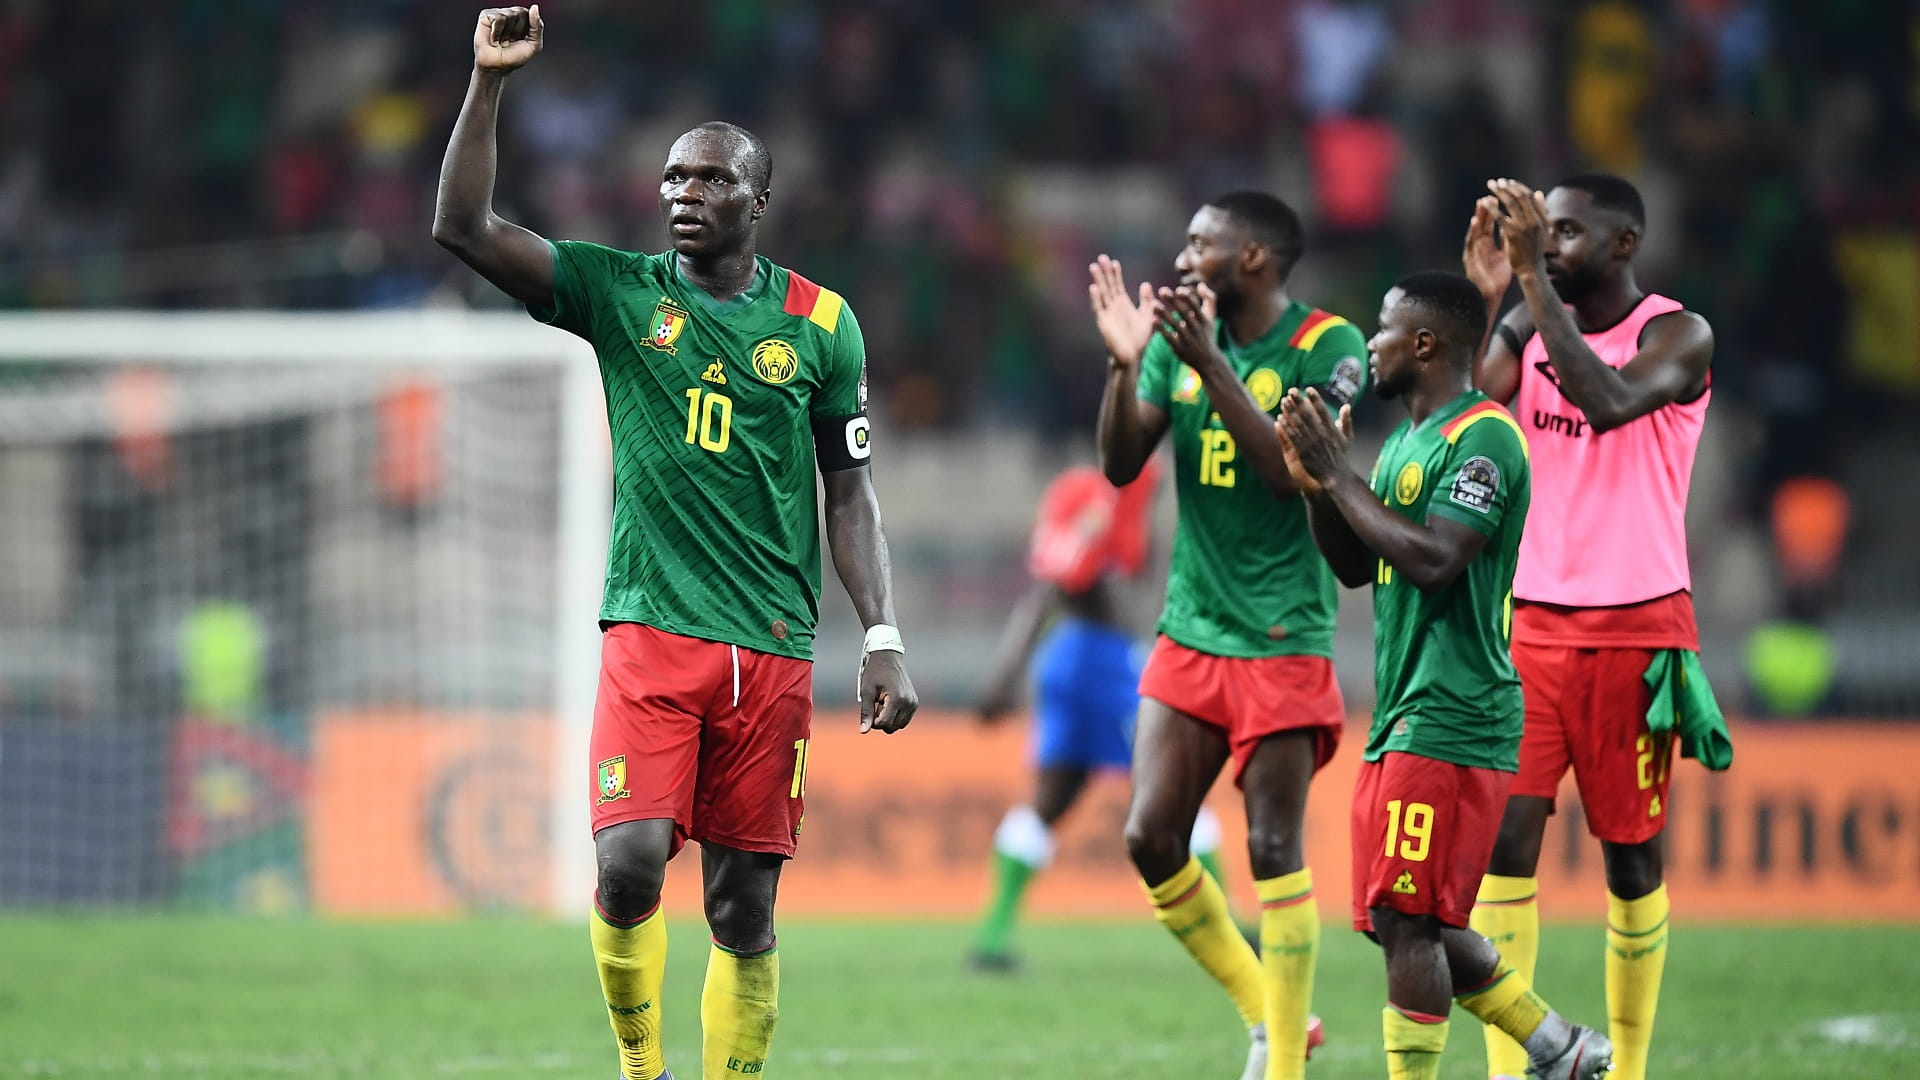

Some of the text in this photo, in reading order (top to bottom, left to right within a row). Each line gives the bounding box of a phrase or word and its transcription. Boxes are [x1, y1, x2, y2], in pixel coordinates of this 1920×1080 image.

[684, 387, 733, 453] 10
[845, 416, 871, 460] C
[1199, 428, 1236, 488] 12
[790, 738, 809, 799] 1
[1384, 799, 1435, 862] 19
[726, 1056, 742, 1072] LE
